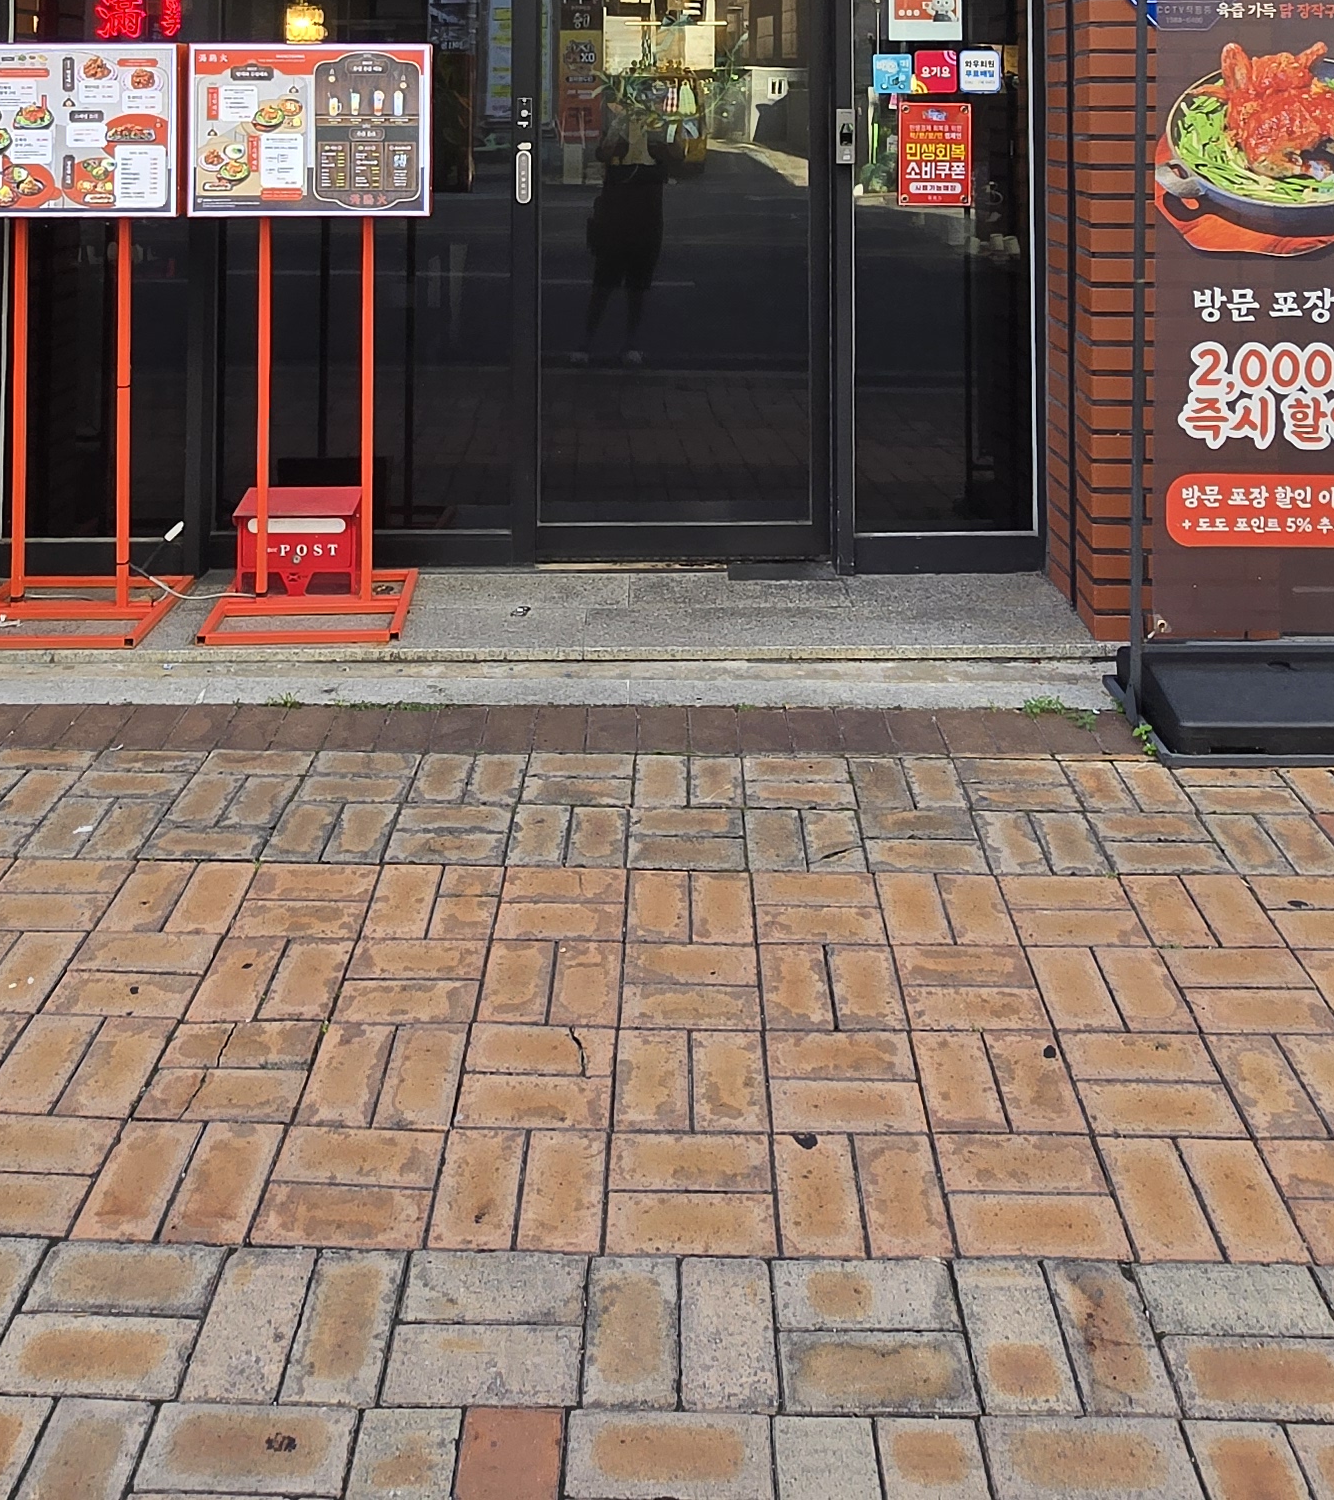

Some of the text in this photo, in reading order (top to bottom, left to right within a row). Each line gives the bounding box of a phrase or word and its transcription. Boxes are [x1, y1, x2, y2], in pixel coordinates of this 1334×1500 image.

[1216, 2, 1245, 19] 육즙
[1247, 2, 1277, 19] 가득
[1279, 3, 1293, 19] 닭
[920, 66, 951, 78] 요기요
[906, 143, 965, 161] 민생회복
[905, 161, 966, 179] 소비쿠폰
[1193, 286, 1260, 323] 방문
[1184, 395, 1270, 442] 즉시
[1181, 485, 1223, 508] 방문
[1227, 485, 1269, 508] 포장
[1274, 486, 1312, 509] 할인
[1196, 517, 1230, 533] 도도
[1233, 516, 1282, 534] 포인트
[1286, 518, 1312, 534] 5%
[280, 543, 338, 556] POST
